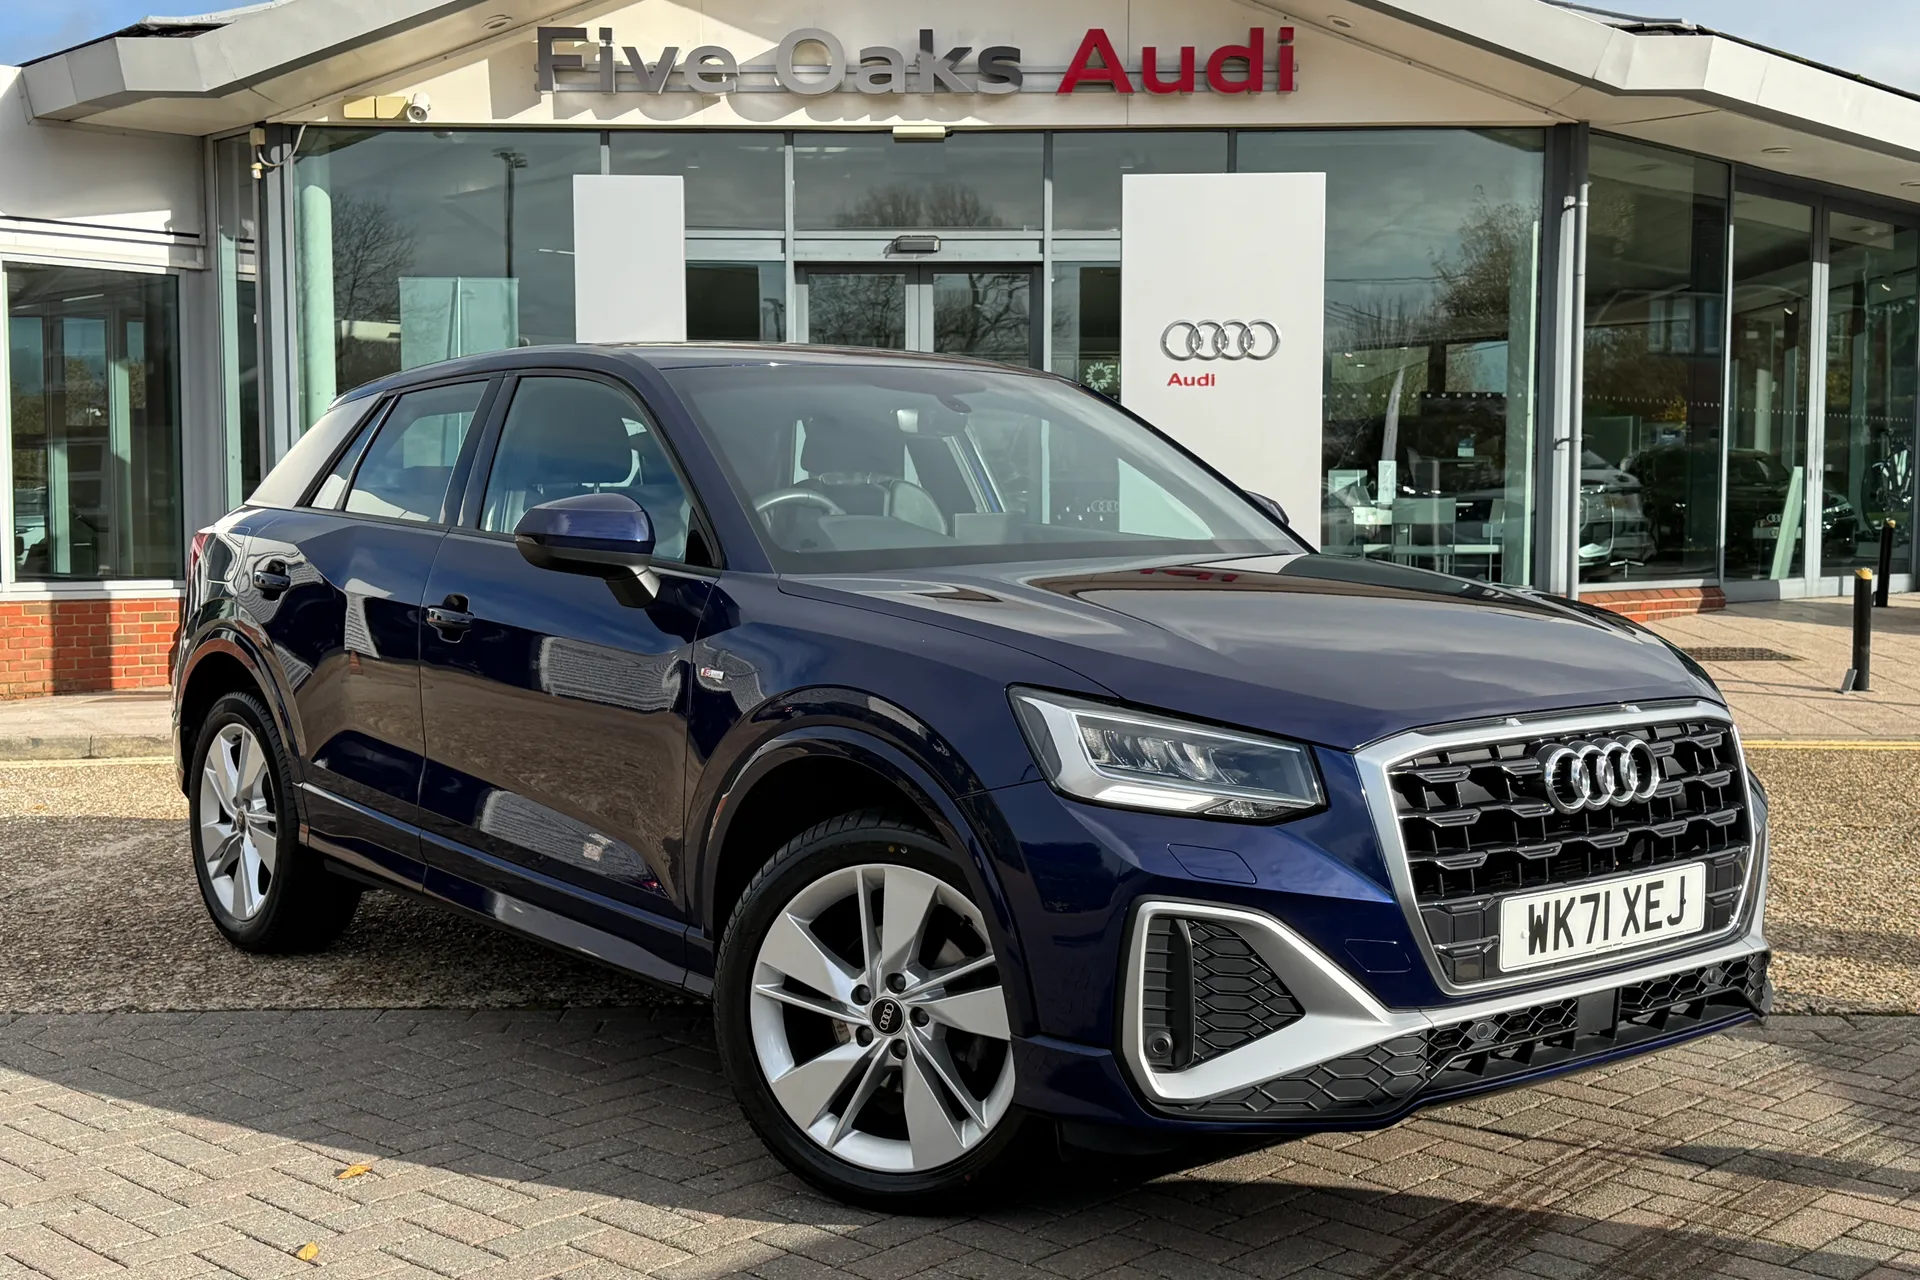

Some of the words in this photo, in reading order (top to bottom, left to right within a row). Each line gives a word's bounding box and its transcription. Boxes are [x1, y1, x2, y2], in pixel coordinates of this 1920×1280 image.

[537, 27, 740, 94] Five
[776, 27, 1023, 95] Oaks
[1056, 27, 1295, 95] Audi
[1167, 372, 1216, 387] Audi
[1528, 890, 1610, 956] WK71
[1621, 876, 1686, 937] XEJ
